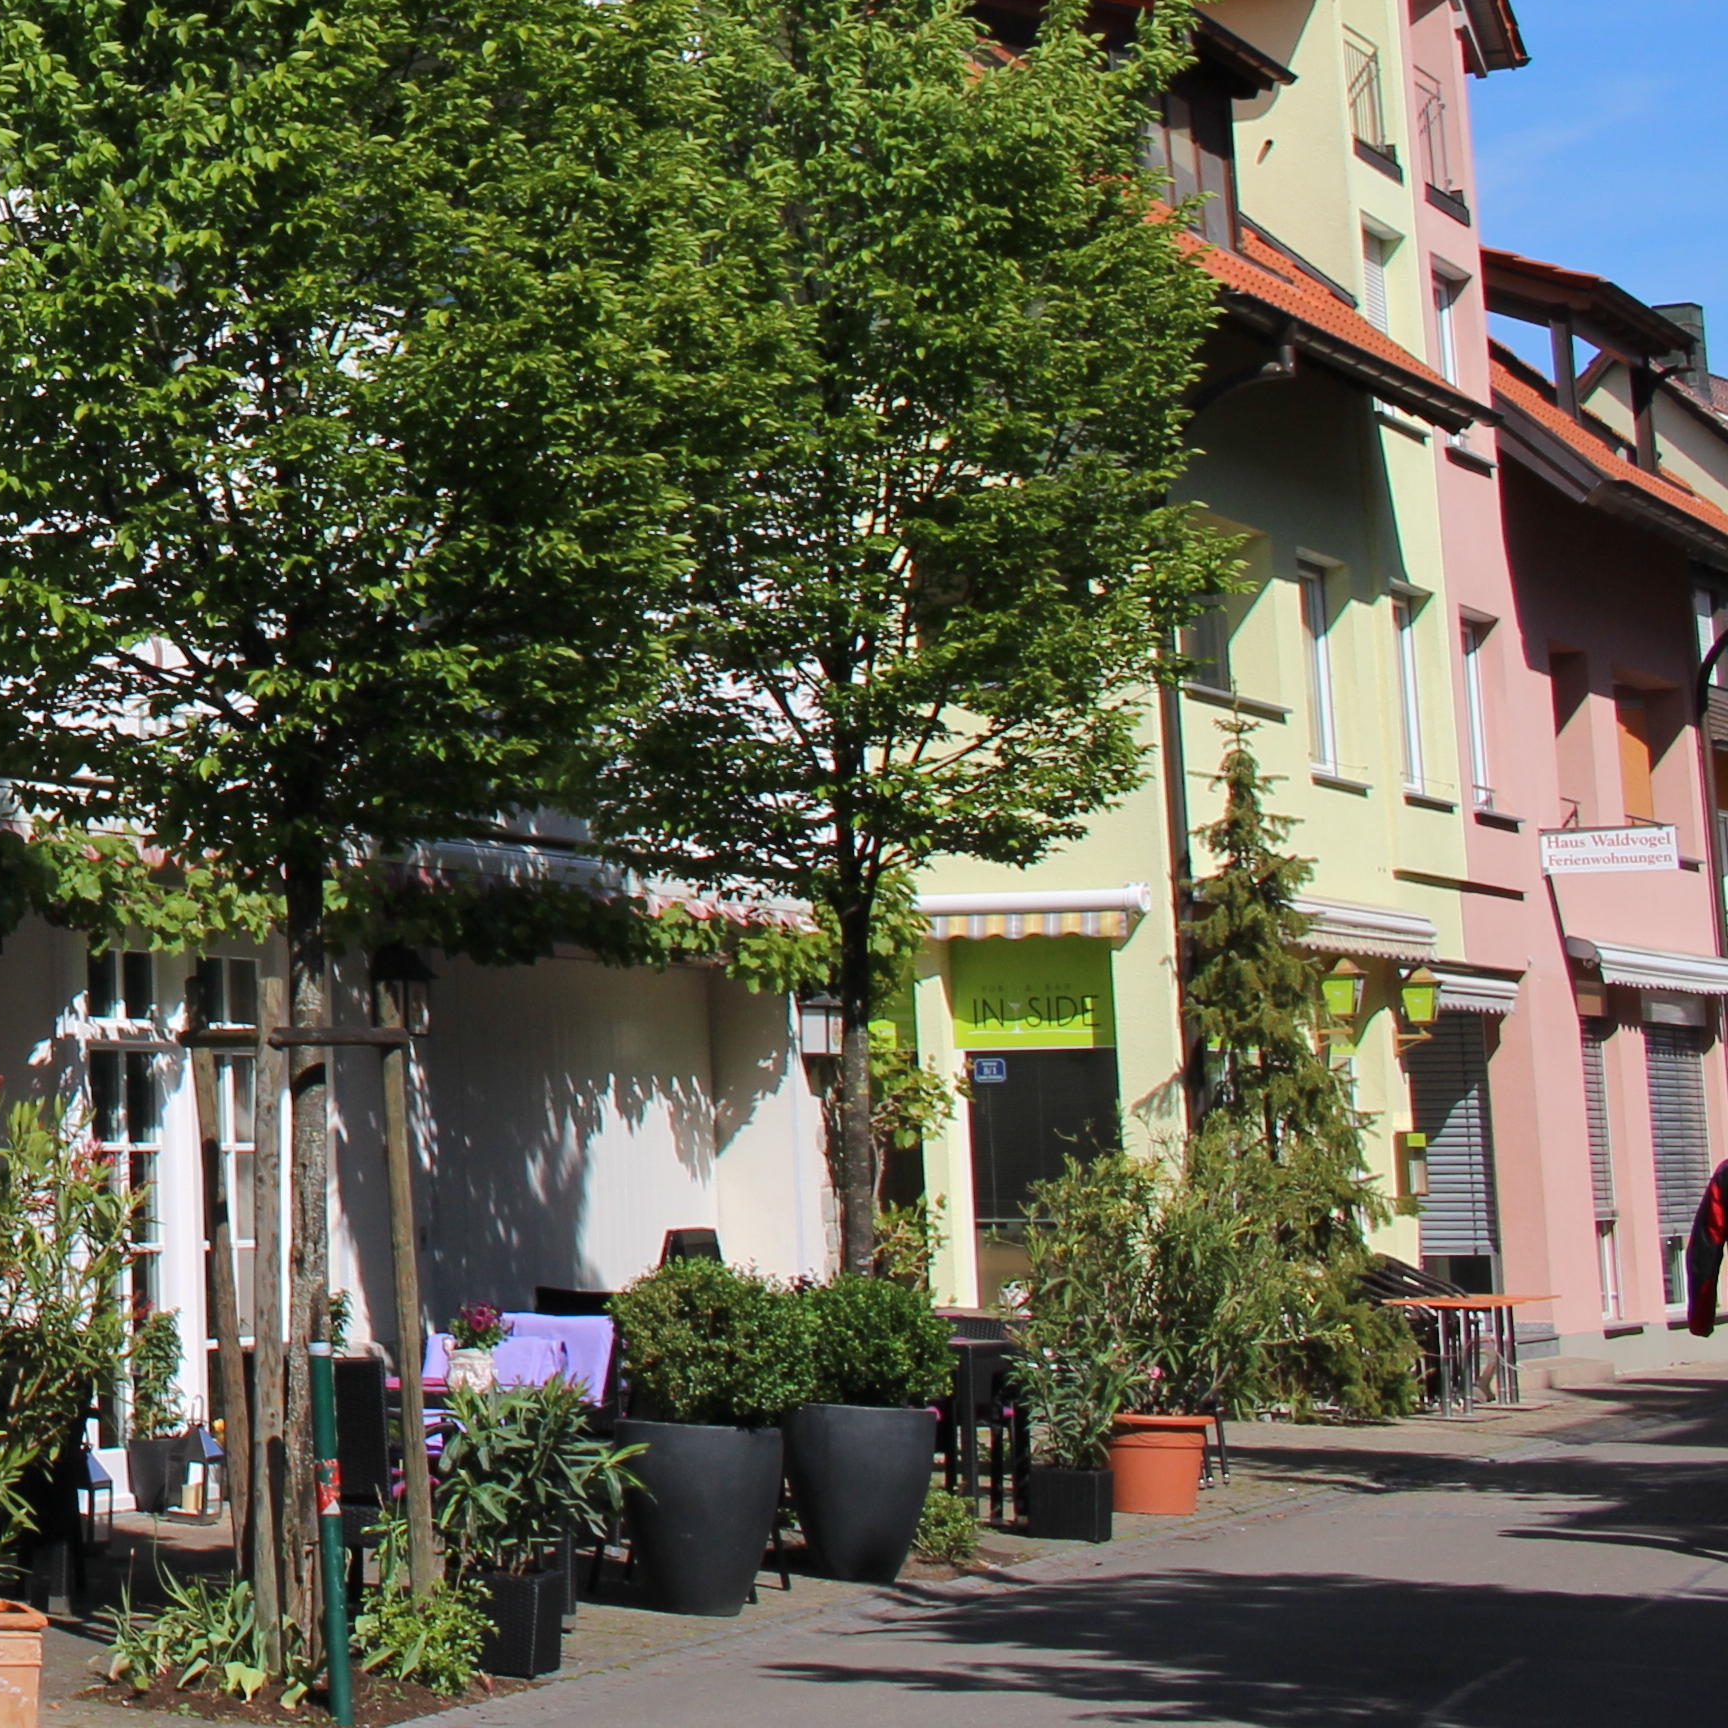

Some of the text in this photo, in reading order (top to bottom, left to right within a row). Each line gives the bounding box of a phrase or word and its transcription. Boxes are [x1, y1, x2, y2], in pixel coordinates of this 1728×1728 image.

[1547, 832, 1672, 849] Haus Waldvogel
[1548, 852, 1673, 866] Ferienwohnungen
[1027, 995, 1100, 1028] SIDE
